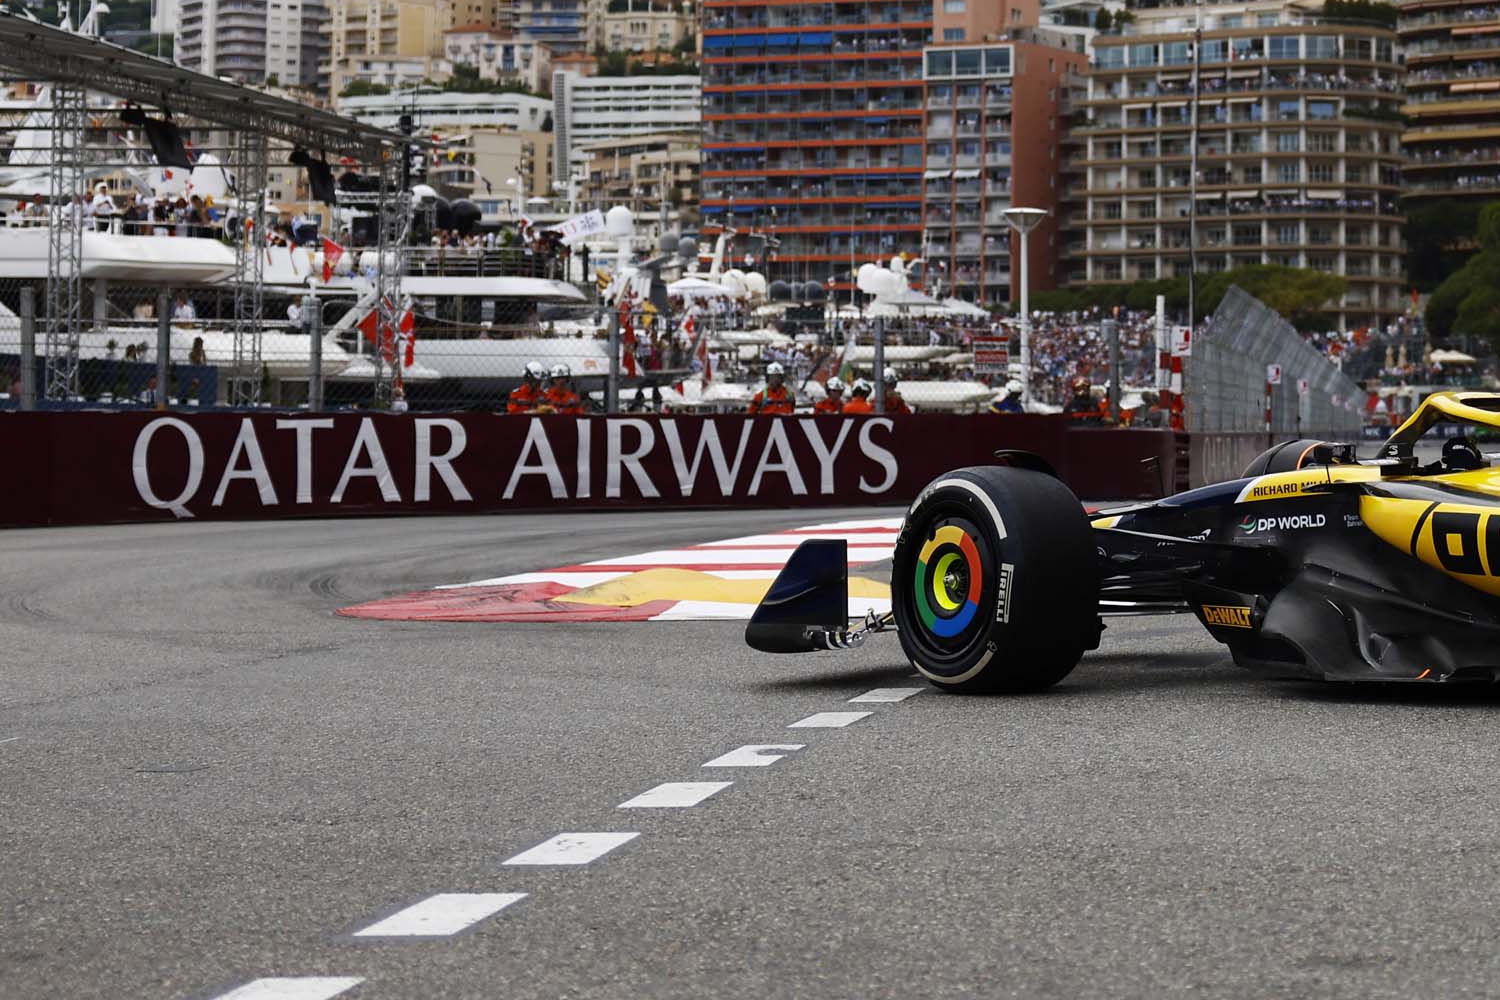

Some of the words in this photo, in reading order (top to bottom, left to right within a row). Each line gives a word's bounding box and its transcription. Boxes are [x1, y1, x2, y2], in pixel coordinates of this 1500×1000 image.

[132, 417, 472, 518] QATAR
[502, 417, 898, 499] AIRWAYS
[1253, 483, 1298, 497] RICHARD
[1257, 517, 1277, 532] DP
[1277, 514, 1326, 530] WORLD
[996, 562, 1014, 624] PIRELLI
